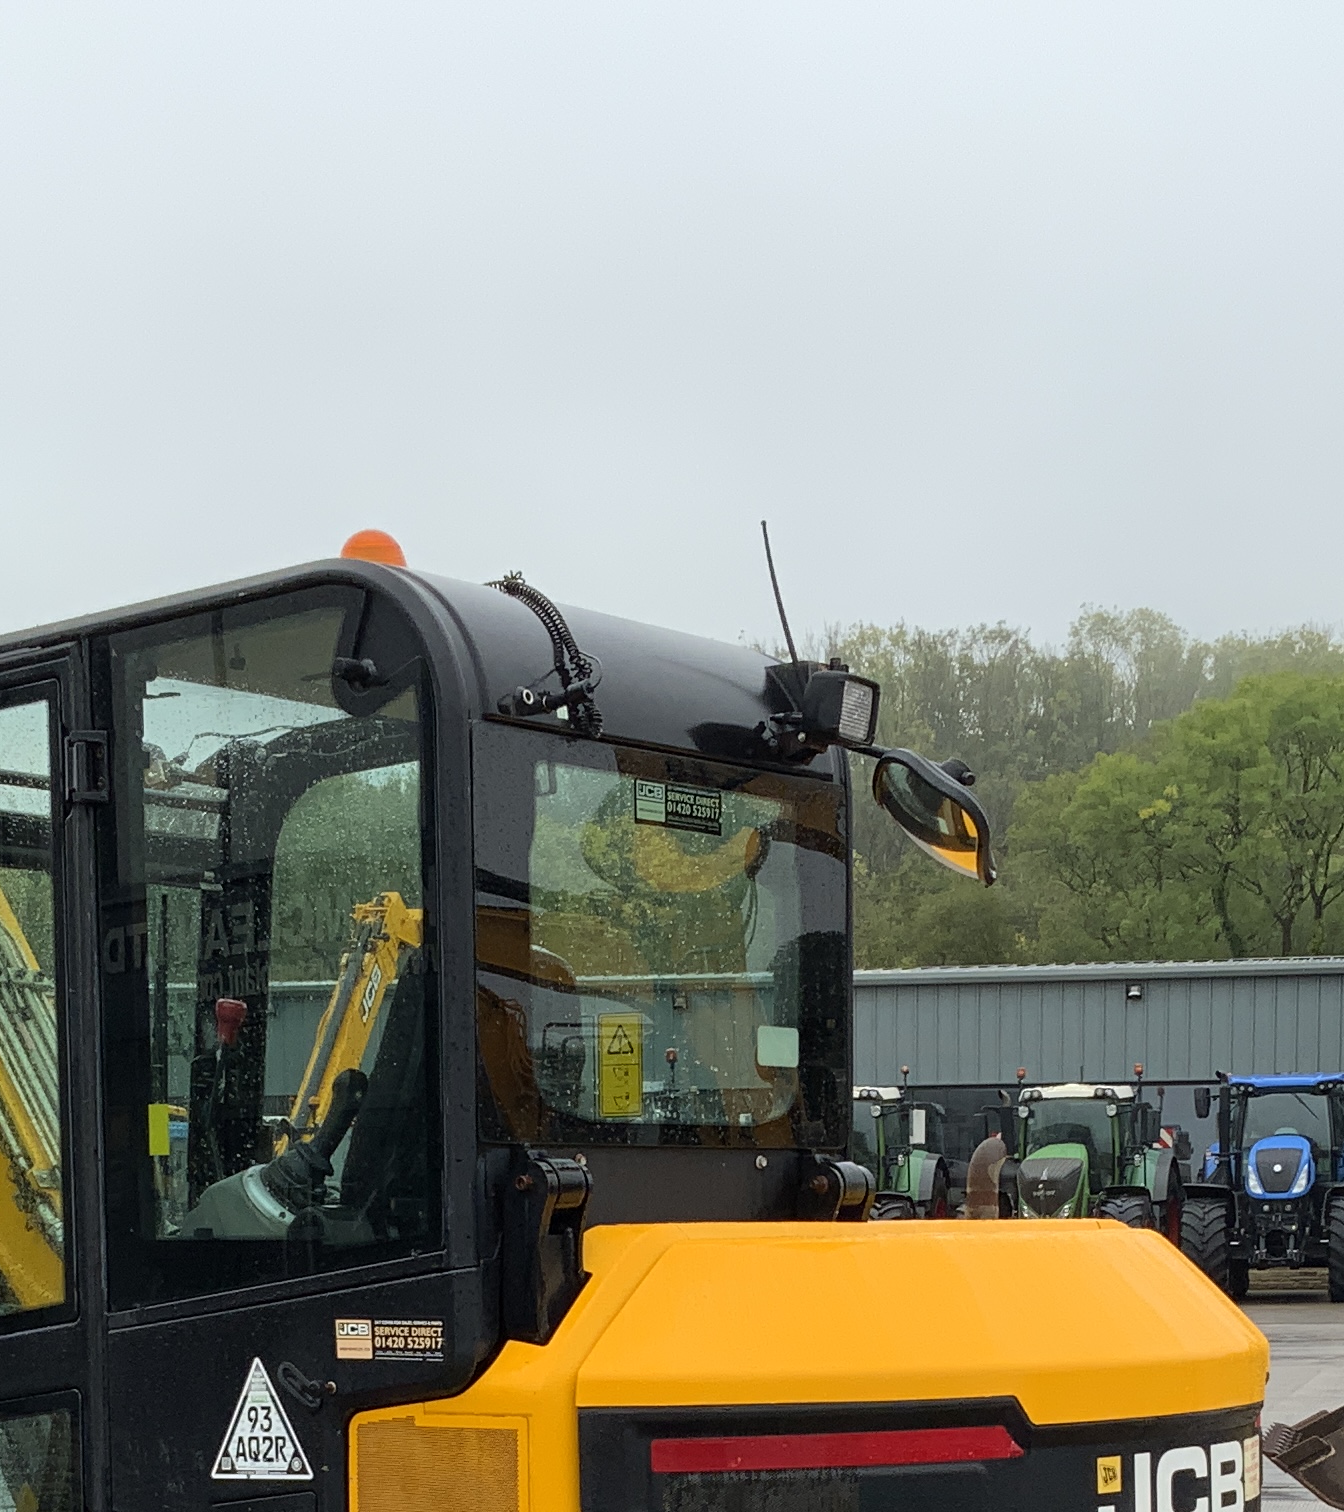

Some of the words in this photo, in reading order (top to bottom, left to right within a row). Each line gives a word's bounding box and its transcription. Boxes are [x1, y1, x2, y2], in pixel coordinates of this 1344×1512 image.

[639, 785, 663, 799] JCB
[667, 791, 695, 804] SERVICE
[696, 796, 720, 807] DIRECT
[667, 801, 691, 815] 01420
[693, 805, 720, 820] 525917
[339, 1323, 369, 1336] JCB
[374, 1326, 410, 1336] SERVICE
[411, 1327, 443, 1337] DIRECT
[374, 1337, 405, 1349] 01420
[407, 1337, 443, 1349] 525917
[247, 1405, 273, 1433] 93
[235, 1436, 288, 1463] AQ2R
